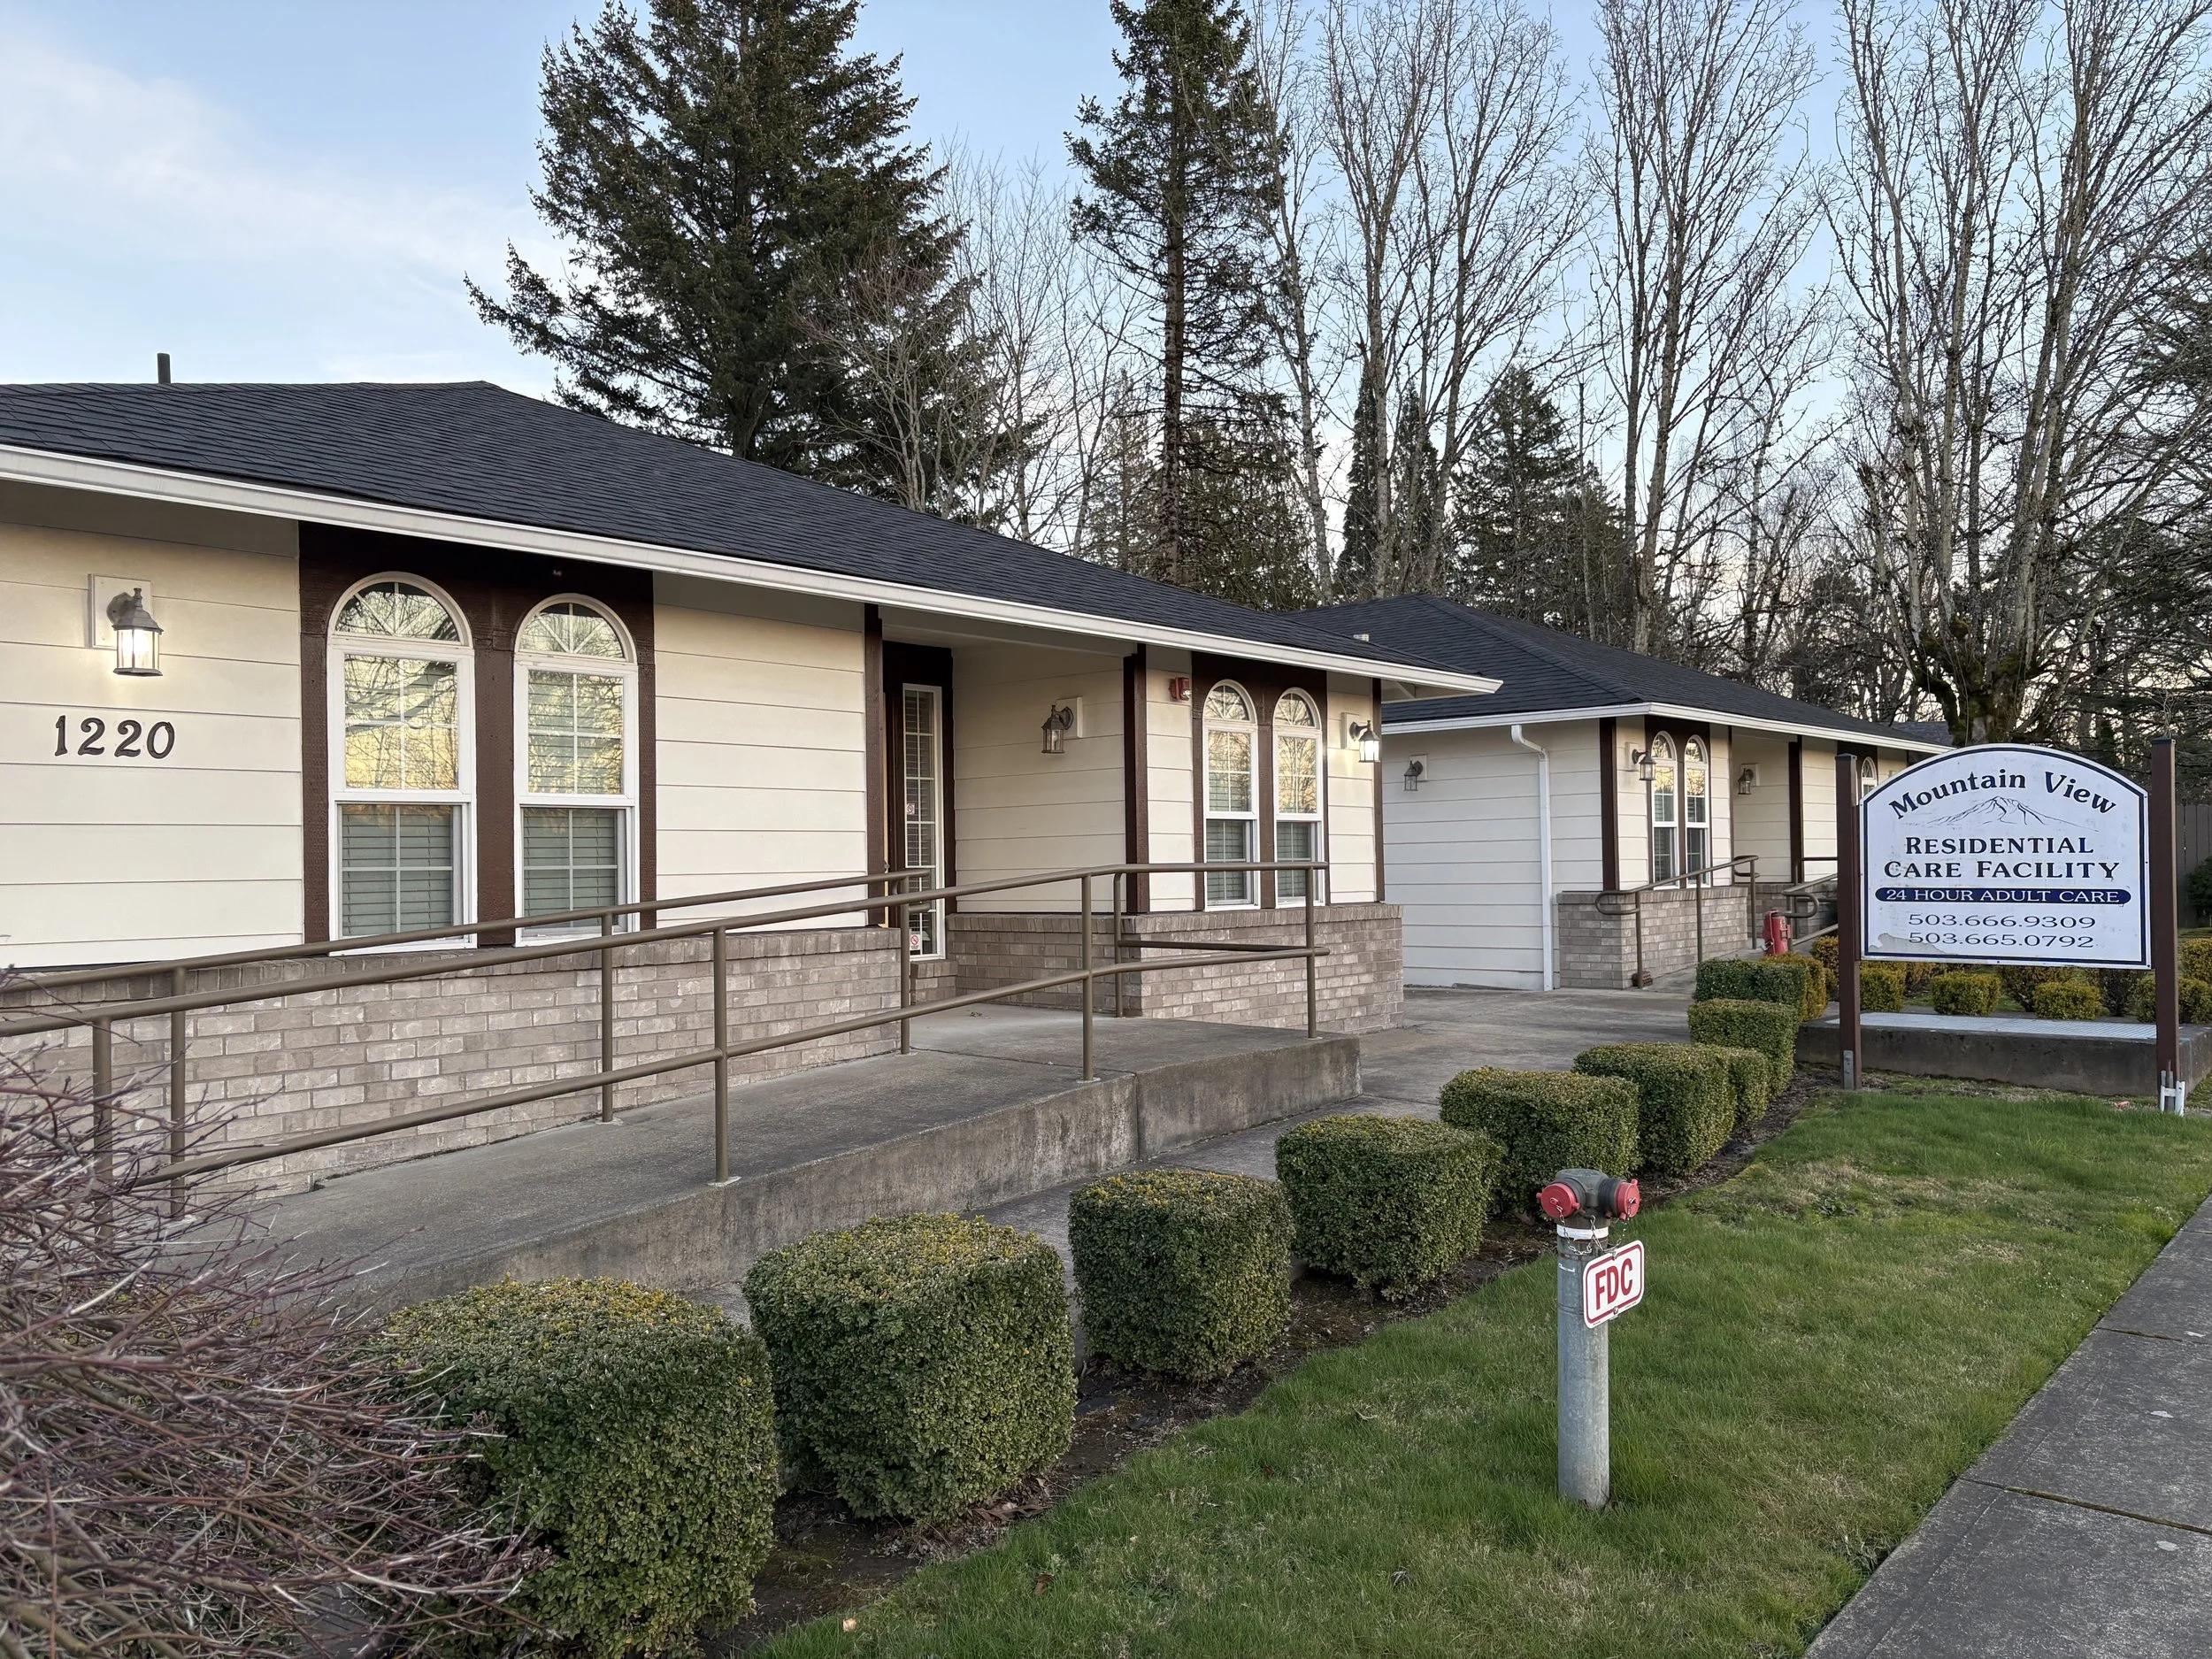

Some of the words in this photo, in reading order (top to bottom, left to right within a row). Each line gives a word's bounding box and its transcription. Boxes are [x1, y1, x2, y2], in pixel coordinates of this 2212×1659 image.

[55, 715, 175, 759] 1220
[1888, 769, 2026, 819] Mountain
[2045, 772, 2116, 814] View
[1906, 837, 2094, 855] RESIDENTIAL
[1884, 861, 1962, 878] CARE
[1977, 861, 2120, 879] FACILITY
[1886, 890, 1907, 901] 24
[1914, 890, 1974, 901] HOUR
[1979, 890, 2051, 902] ADULT
[2059, 891, 2119, 902] CARE
[1908, 914, 2096, 928] 503.666.9309
[1909, 932, 2094, 948] 503.665.0792
[1595, 1258, 1632, 1310] FDC
